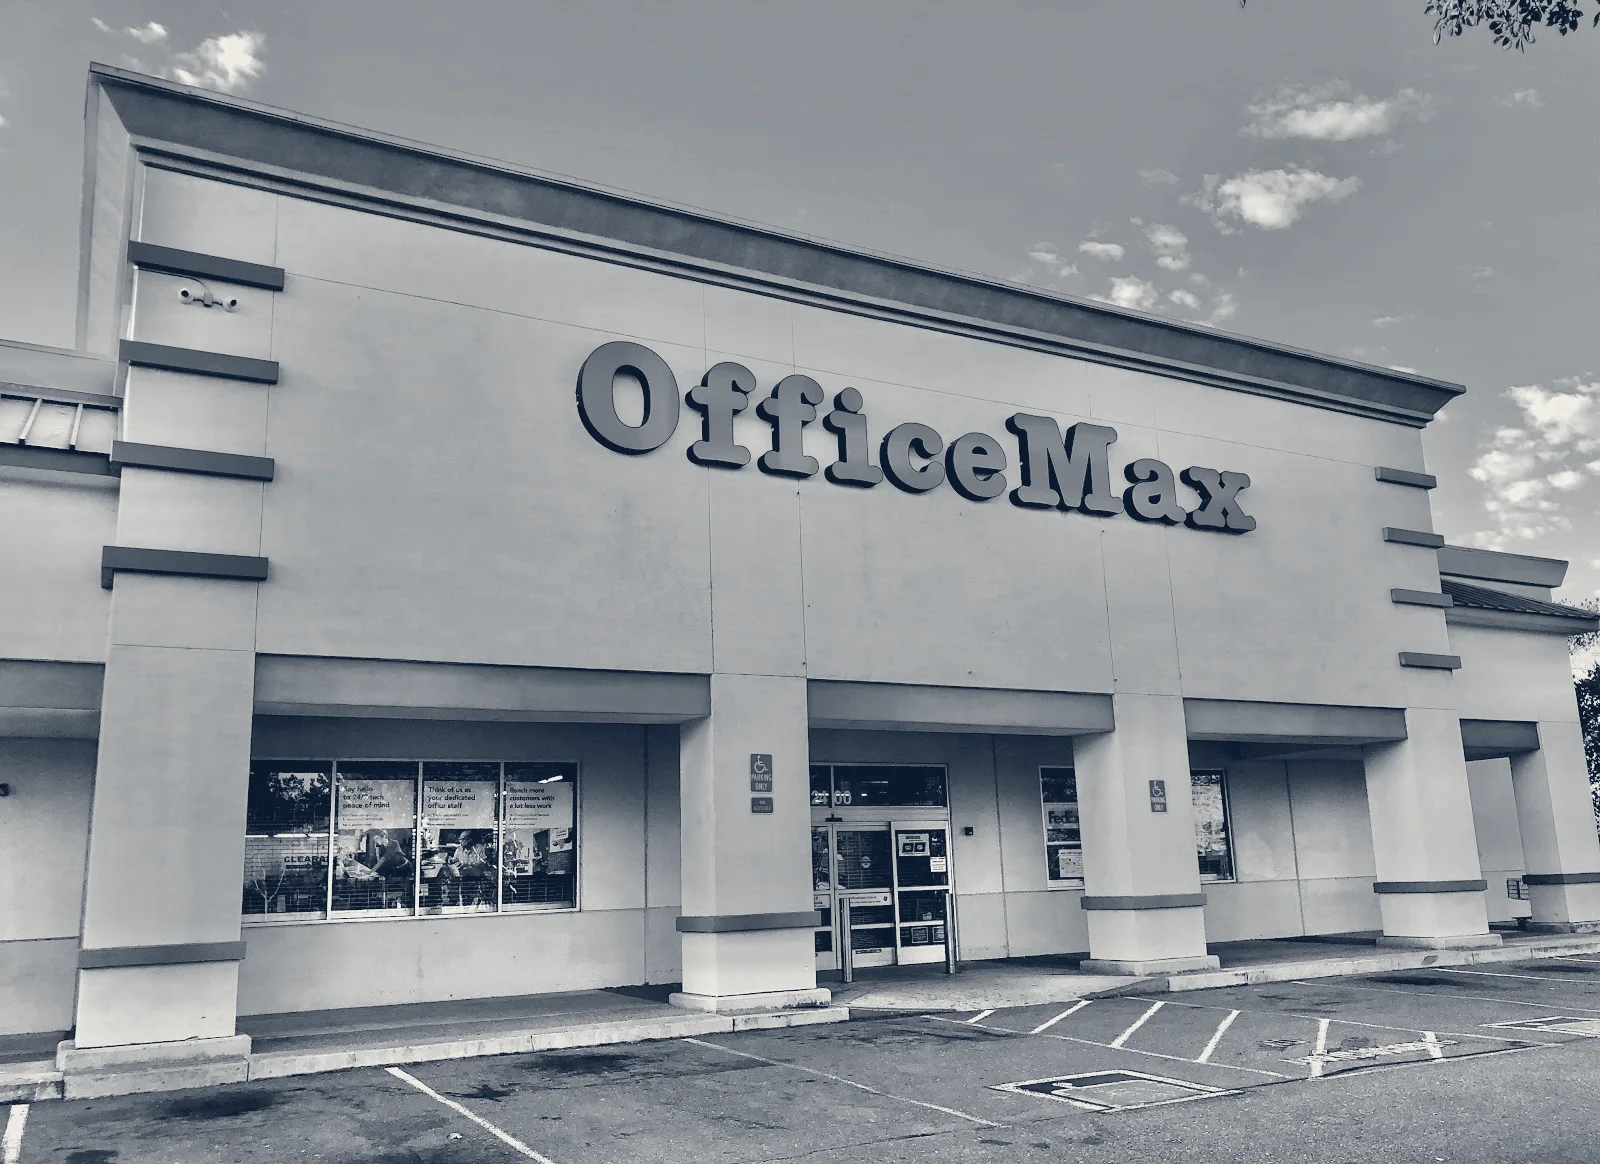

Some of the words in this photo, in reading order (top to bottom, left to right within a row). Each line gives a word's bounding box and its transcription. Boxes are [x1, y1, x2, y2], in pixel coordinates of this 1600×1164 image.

[576, 341, 1256, 534] OfficeMax
[751, 773, 772, 781] PARKING
[755, 782, 768, 791] ONLY
[1048, 810, 1079, 824] FedE
